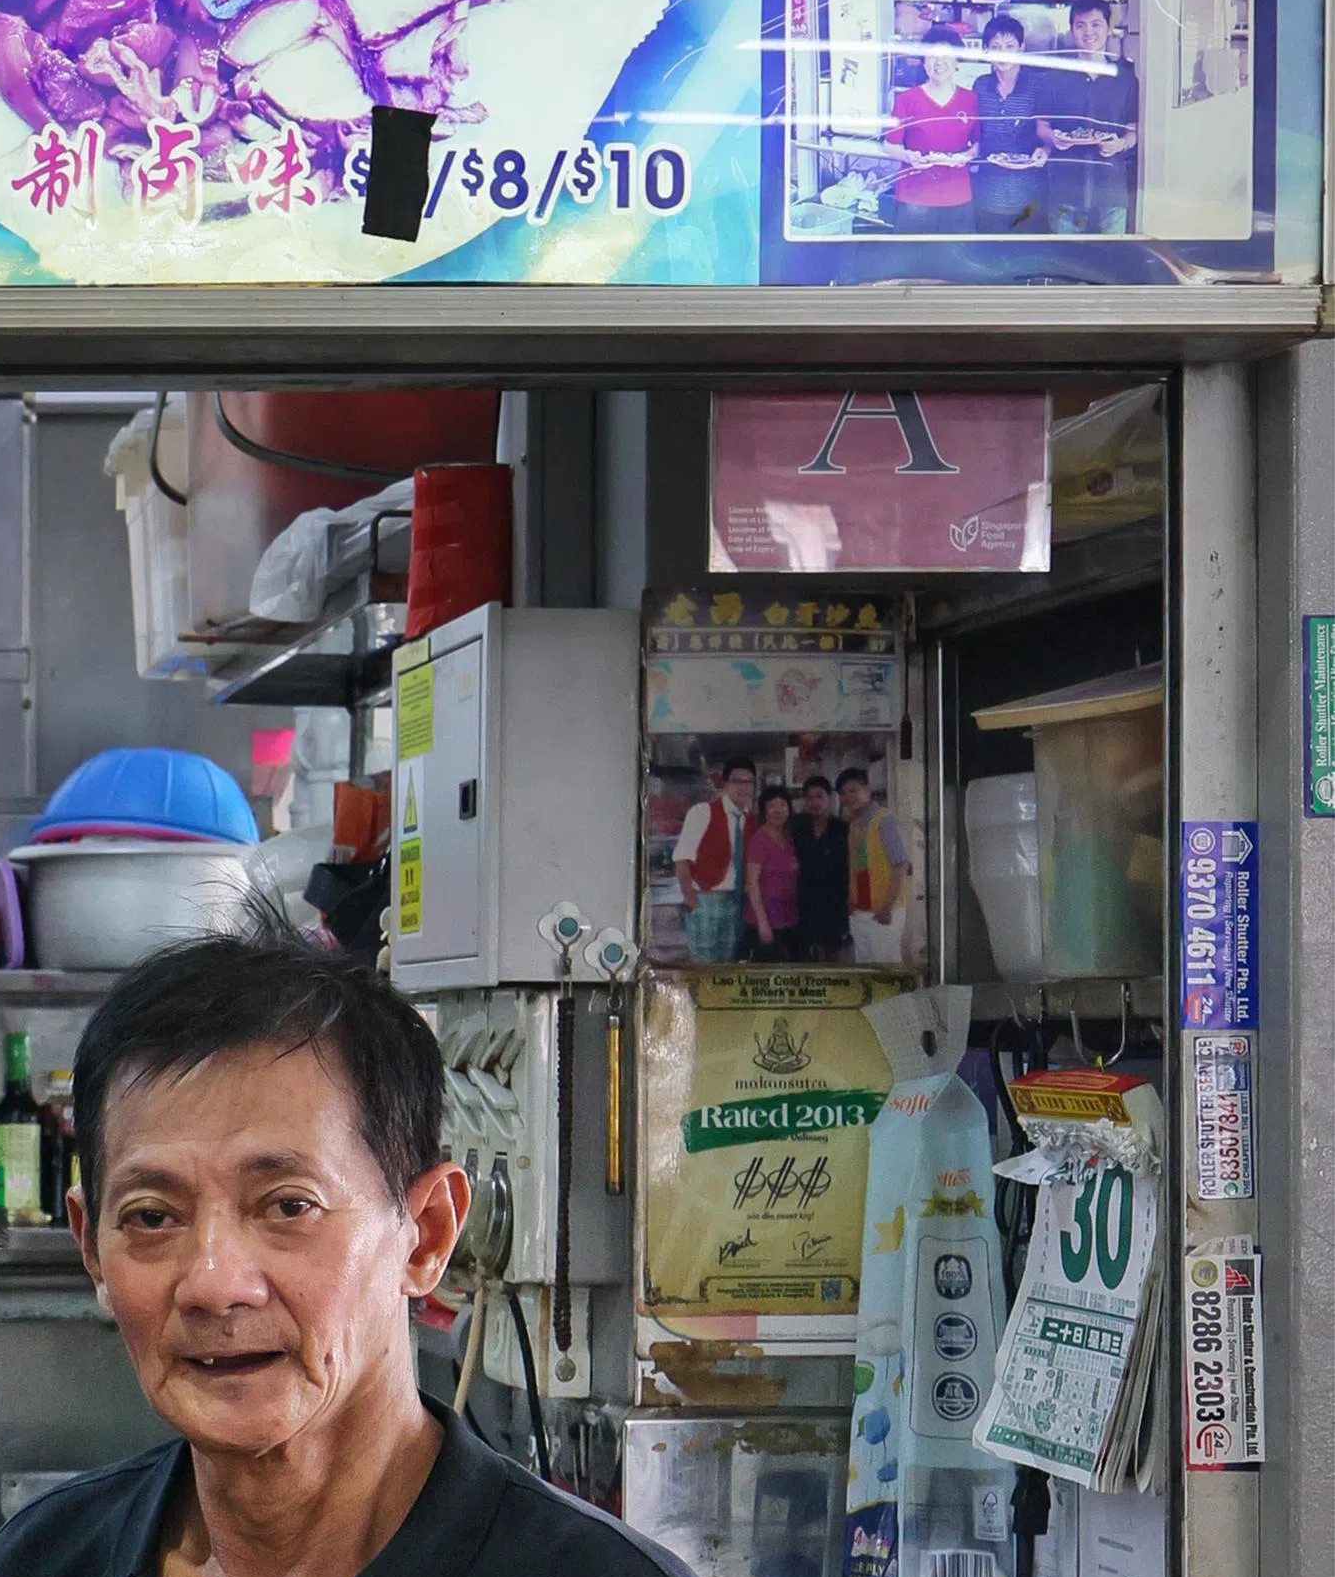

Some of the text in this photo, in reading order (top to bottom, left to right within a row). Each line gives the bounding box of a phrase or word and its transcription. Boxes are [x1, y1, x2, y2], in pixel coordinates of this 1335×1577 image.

[349, 147, 686, 220] $/$8/$10
[981, 531, 1005, 540] Food
[1314, 623, 1328, 767] Roller Shutter Maintenance
[1223, 871, 1234, 913] Repairing
[1186, 858, 1216, 985] 9370 4611
[1237, 871, 1250, 1022] Roller Shutter Pte. Ltd.
[1202, 997, 1213, 1014] 24
[1224, 990, 1234, 1022] Shutter
[734, 1076, 828, 1090] makansutra
[700, 1103, 866, 1129] Rated 2013
[1198, 1040, 1217, 1197] ROLLER SHUTTER SERVICE
[1217, 1092, 1240, 1181] 83507841
[1059, 1164, 1134, 1291] 30
[1242, 1297, 1254, 1323] Roller
[1191, 1290, 1226, 1423] 8286 2303
[1242, 1324, 1255, 1356] Shutter
[1243, 1366, 1258, 1423] Construction
[1212, 1432, 1224, 1448] 24
